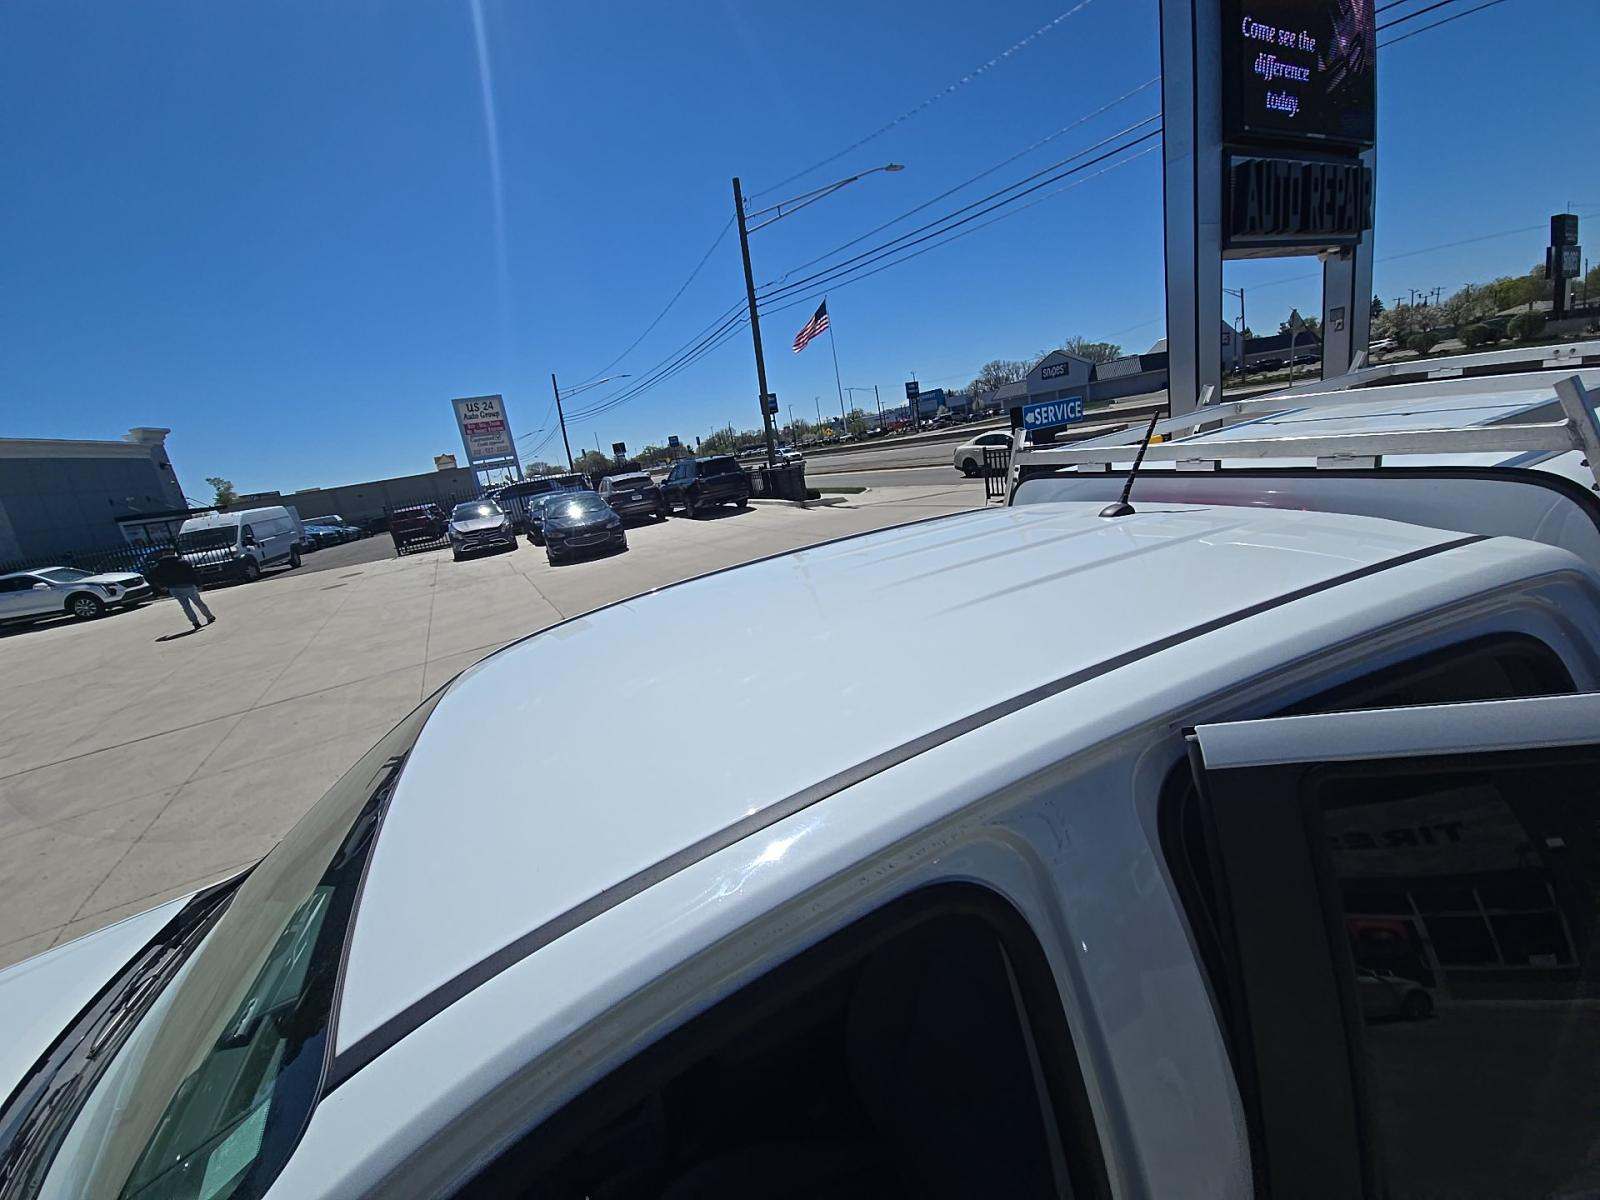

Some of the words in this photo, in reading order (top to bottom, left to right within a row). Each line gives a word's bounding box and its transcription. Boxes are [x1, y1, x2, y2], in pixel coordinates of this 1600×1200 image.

[1242, 16, 1275, 43] Come
[1278, 30, 1296, 48] see
[1299, 31, 1316, 53] the
[1254, 52, 1310, 81] difference
[1248, 159, 1302, 232] AUTO
[1311, 163, 1372, 231] REPAIR
[466, 402, 480, 412] US
[482, 401, 494, 411] 24
[480, 411, 500, 419] Group
[1034, 401, 1082, 425] SERVICE
